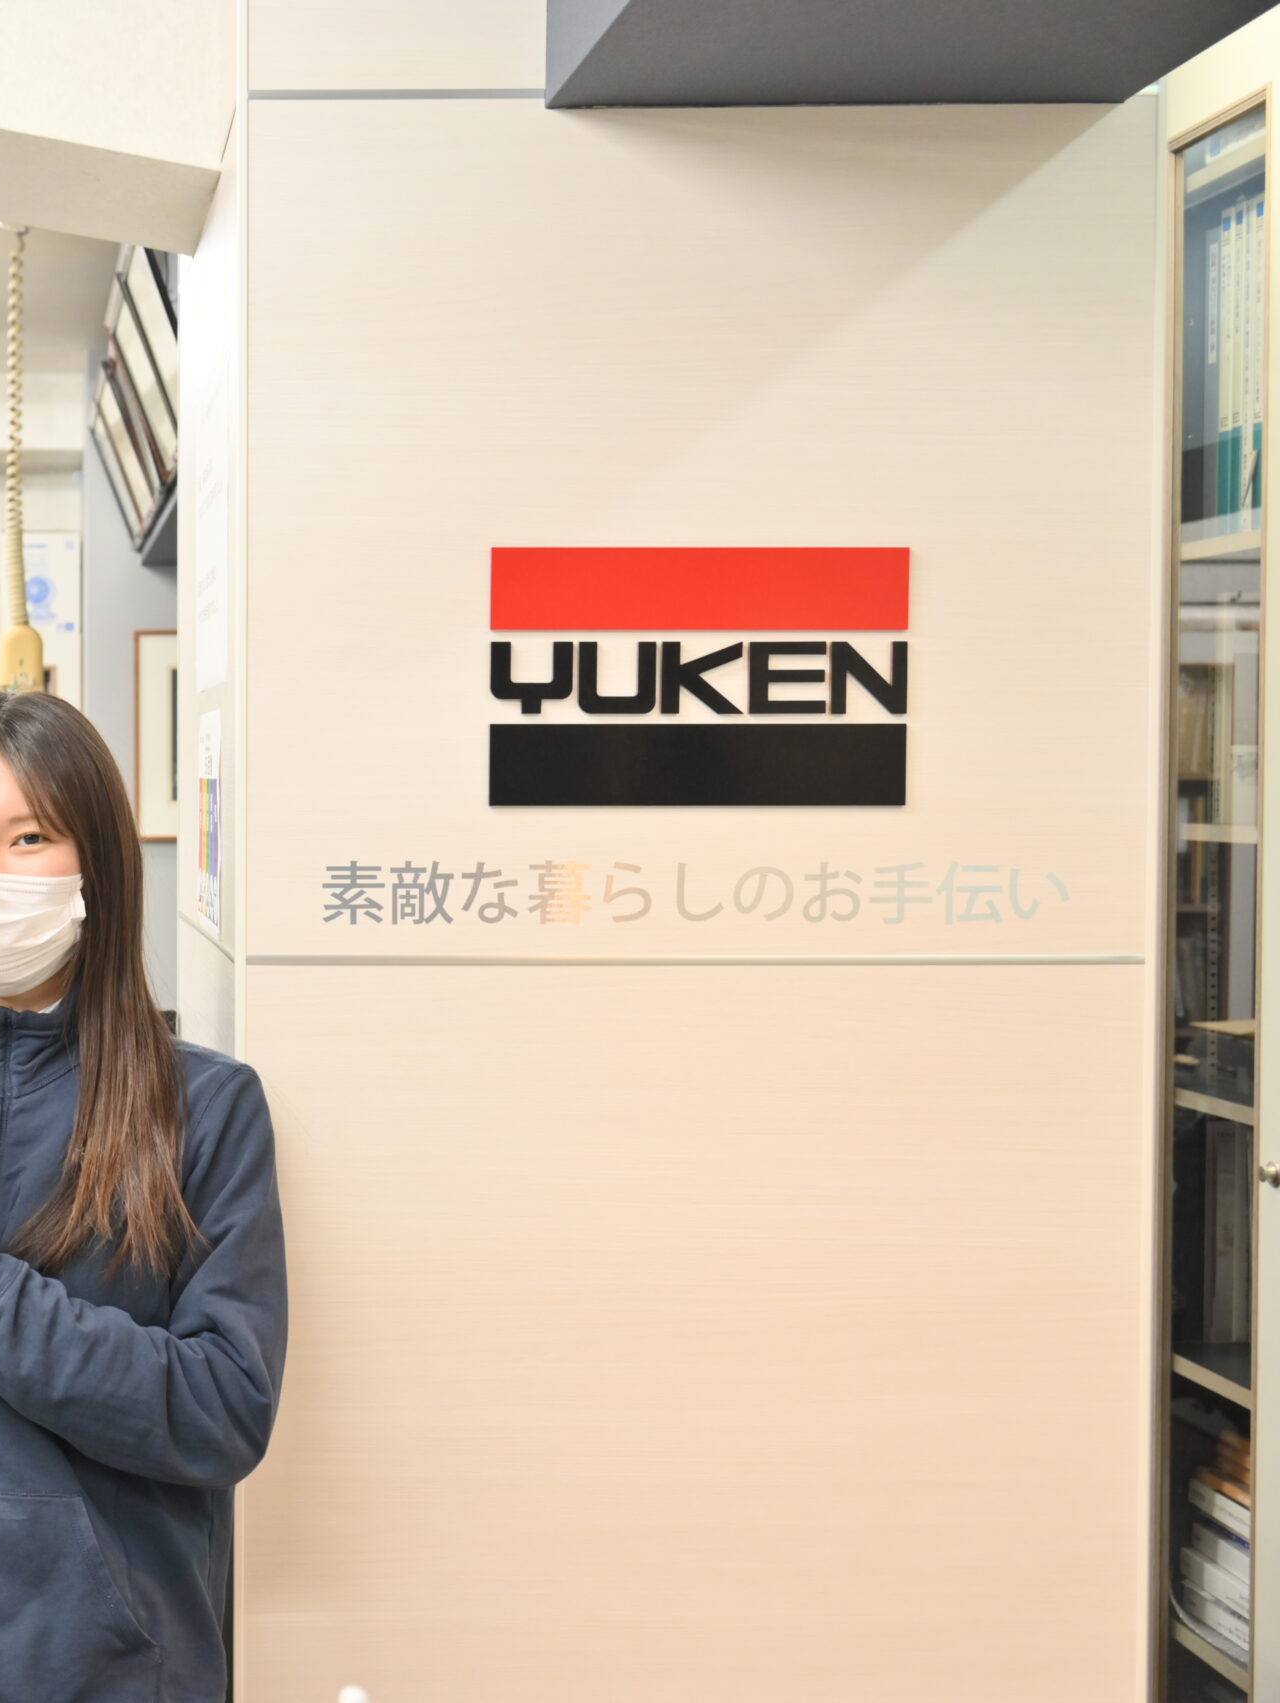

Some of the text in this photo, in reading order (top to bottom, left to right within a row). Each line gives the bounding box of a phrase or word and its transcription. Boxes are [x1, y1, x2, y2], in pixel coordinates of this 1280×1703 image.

[490, 641, 908, 715] YUKEN
[321, 859, 1070, 925] 素敵な暮らしのお手伝い
